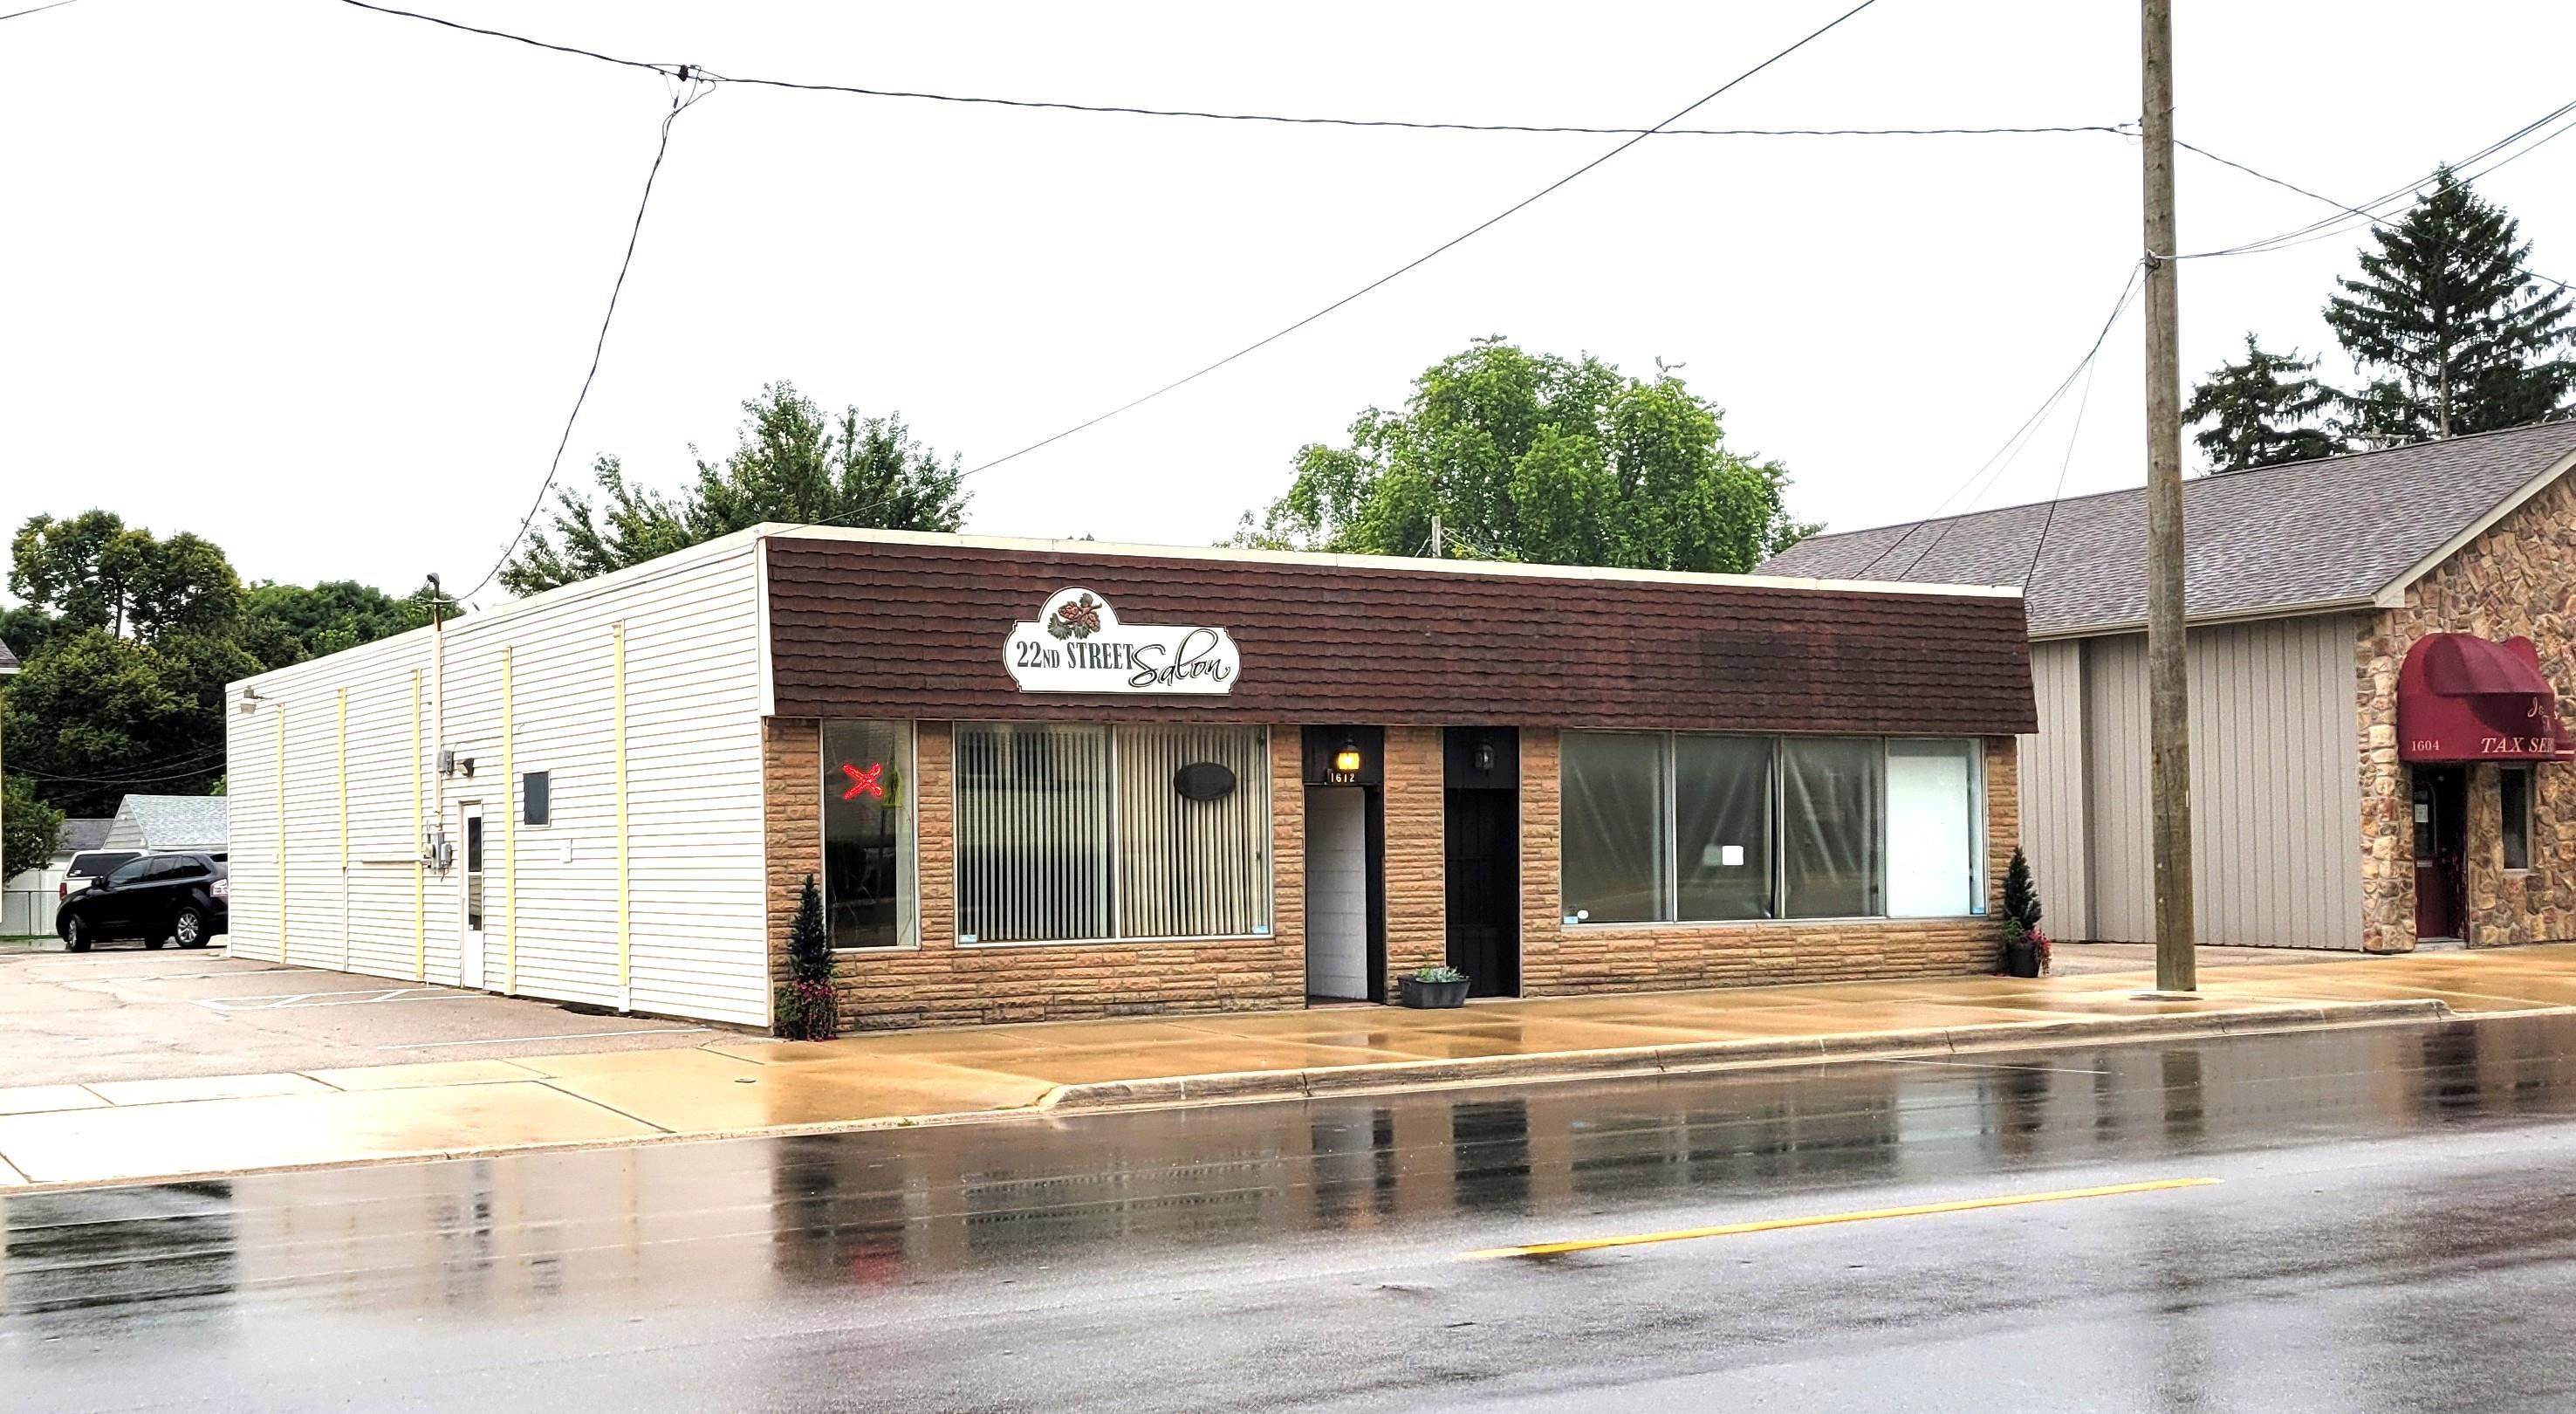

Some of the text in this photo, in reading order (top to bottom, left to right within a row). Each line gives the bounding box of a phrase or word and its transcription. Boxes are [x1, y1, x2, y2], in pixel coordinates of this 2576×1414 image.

[1017, 628, 1231, 688] 22ND STREET Salon
[2411, 739, 2440, 752] 1604
[2481, 737, 2525, 753] TAX
[1331, 772, 1355, 783] 1612
